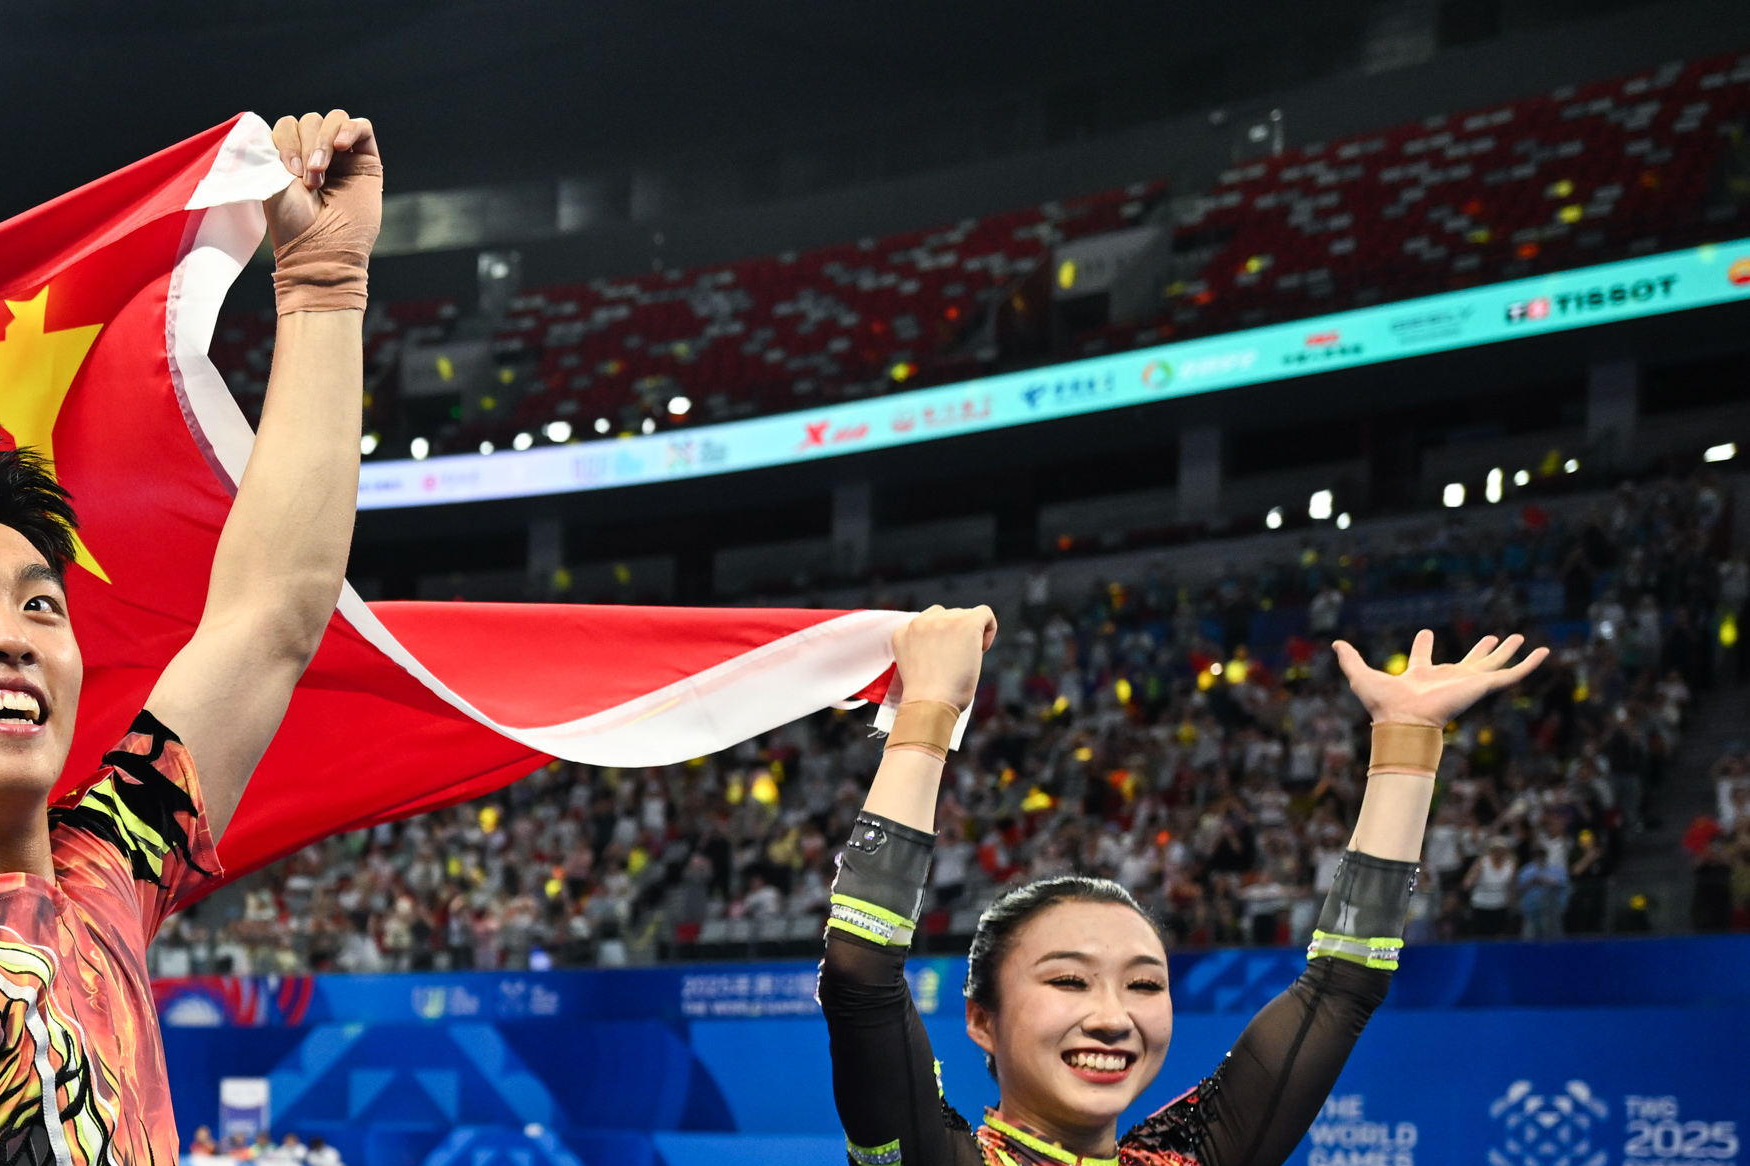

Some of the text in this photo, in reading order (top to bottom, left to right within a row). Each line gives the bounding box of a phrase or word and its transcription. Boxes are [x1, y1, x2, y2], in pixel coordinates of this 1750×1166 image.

[1554, 273, 1678, 315] TISSOT
[1310, 1120, 1418, 1148] WORLD
[1624, 1120, 1738, 1158] 2025
